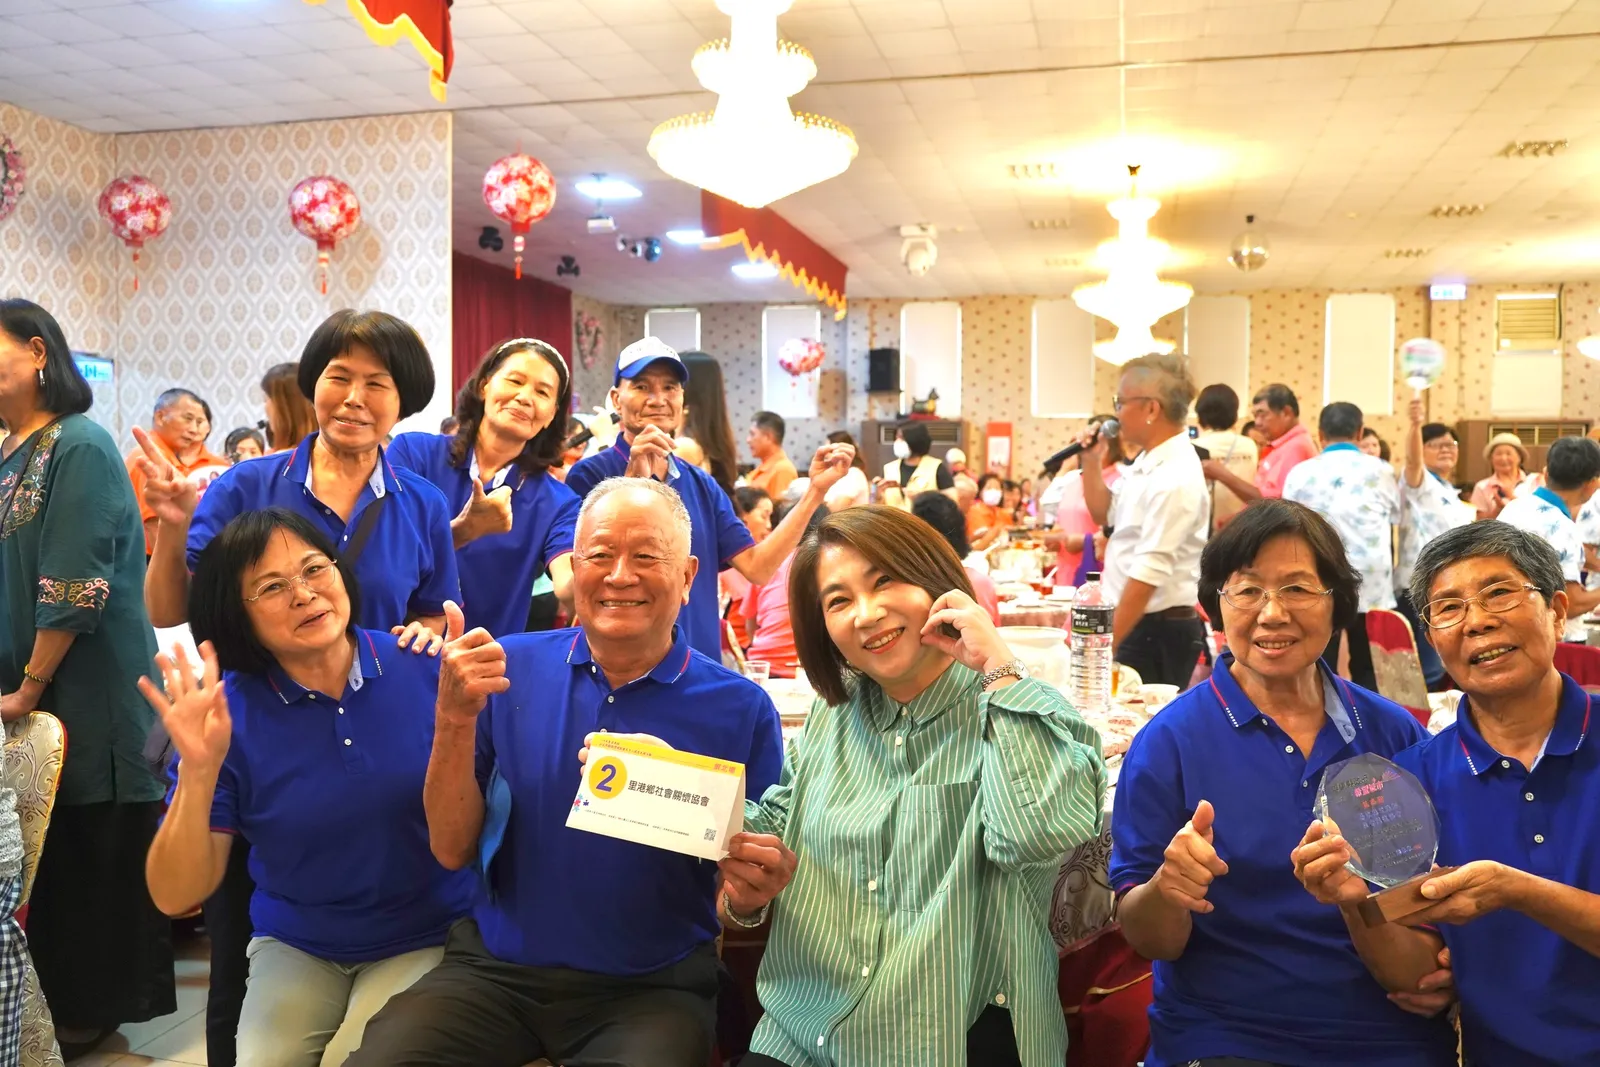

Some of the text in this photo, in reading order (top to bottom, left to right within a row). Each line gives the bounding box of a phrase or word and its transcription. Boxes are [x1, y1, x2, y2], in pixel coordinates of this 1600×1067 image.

[596, 764, 617, 792] 2
[628, 780, 710, 807] 里港鄉社會關懷協會
